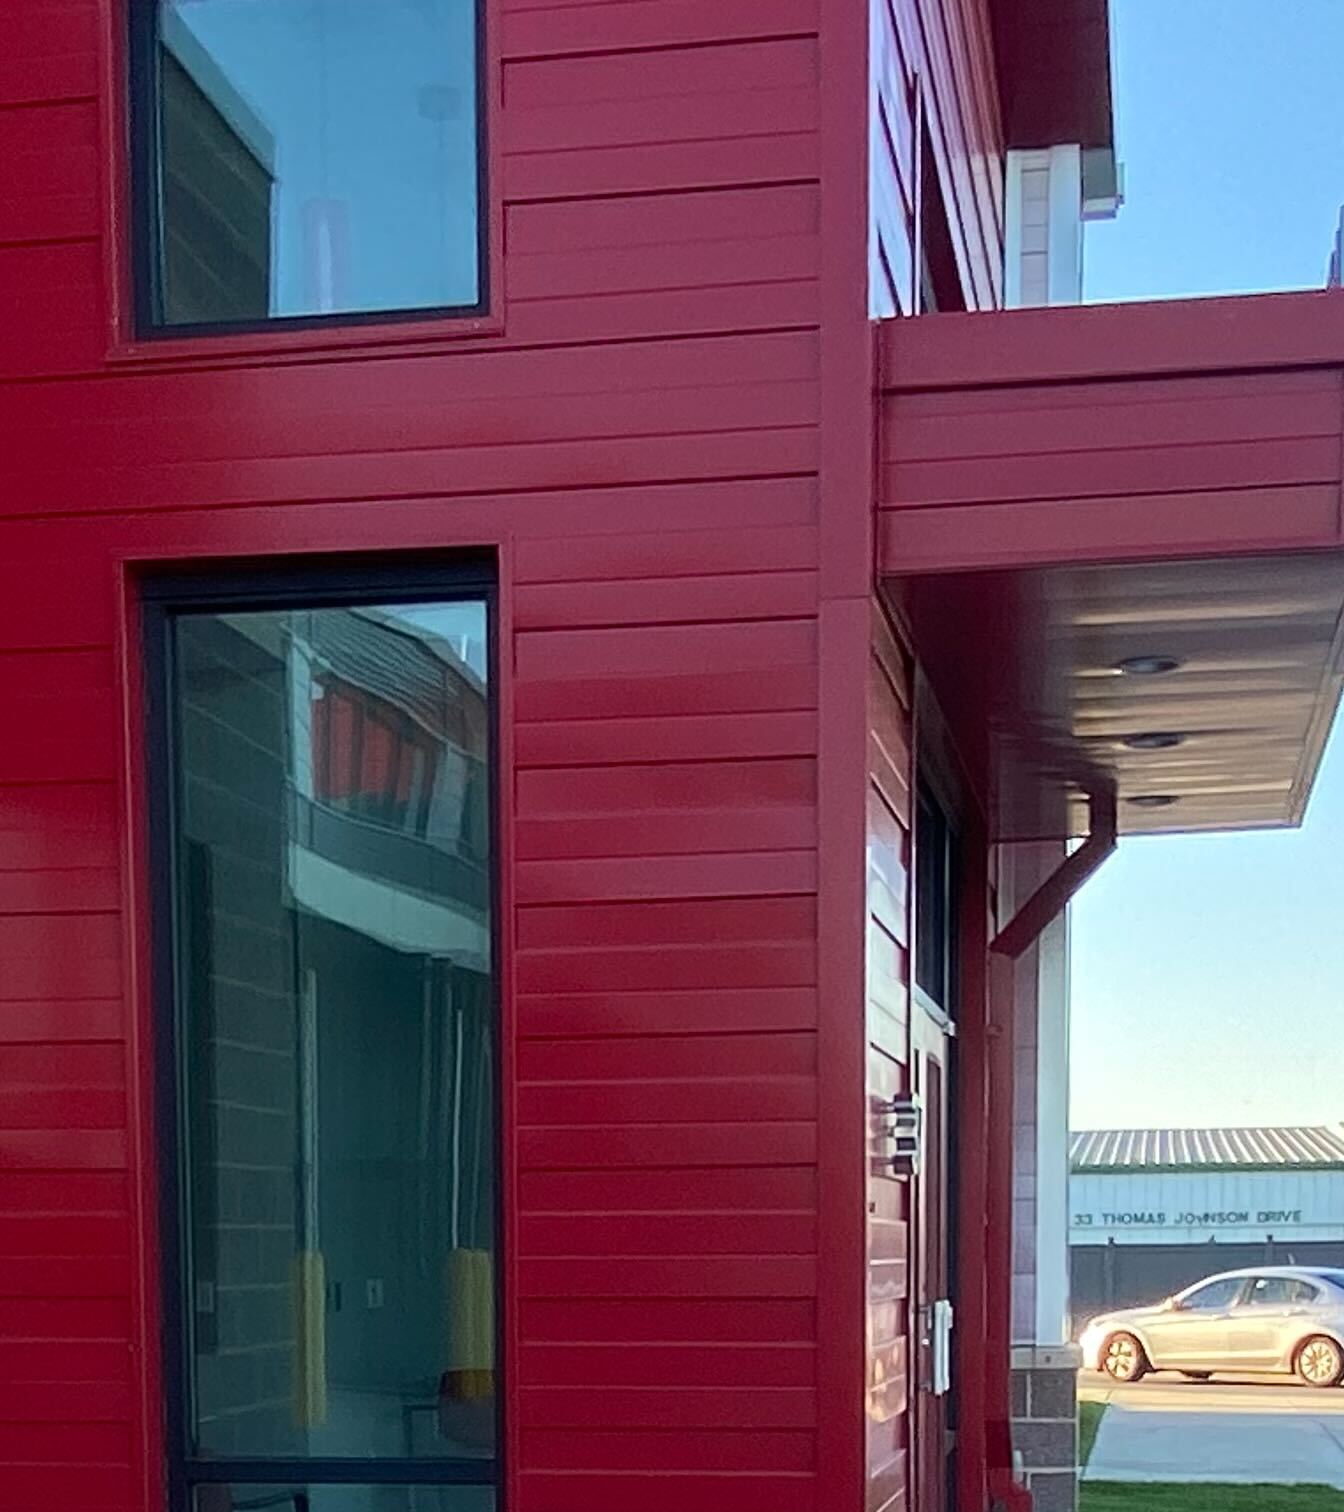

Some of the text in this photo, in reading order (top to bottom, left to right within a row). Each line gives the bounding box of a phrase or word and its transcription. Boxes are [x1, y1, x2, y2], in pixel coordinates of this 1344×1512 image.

[1102, 1212, 1166, 1226] THOMAS
[1174, 1211, 1249, 1226] JOHNSON
[1256, 1210, 1303, 1223] DRIVE
